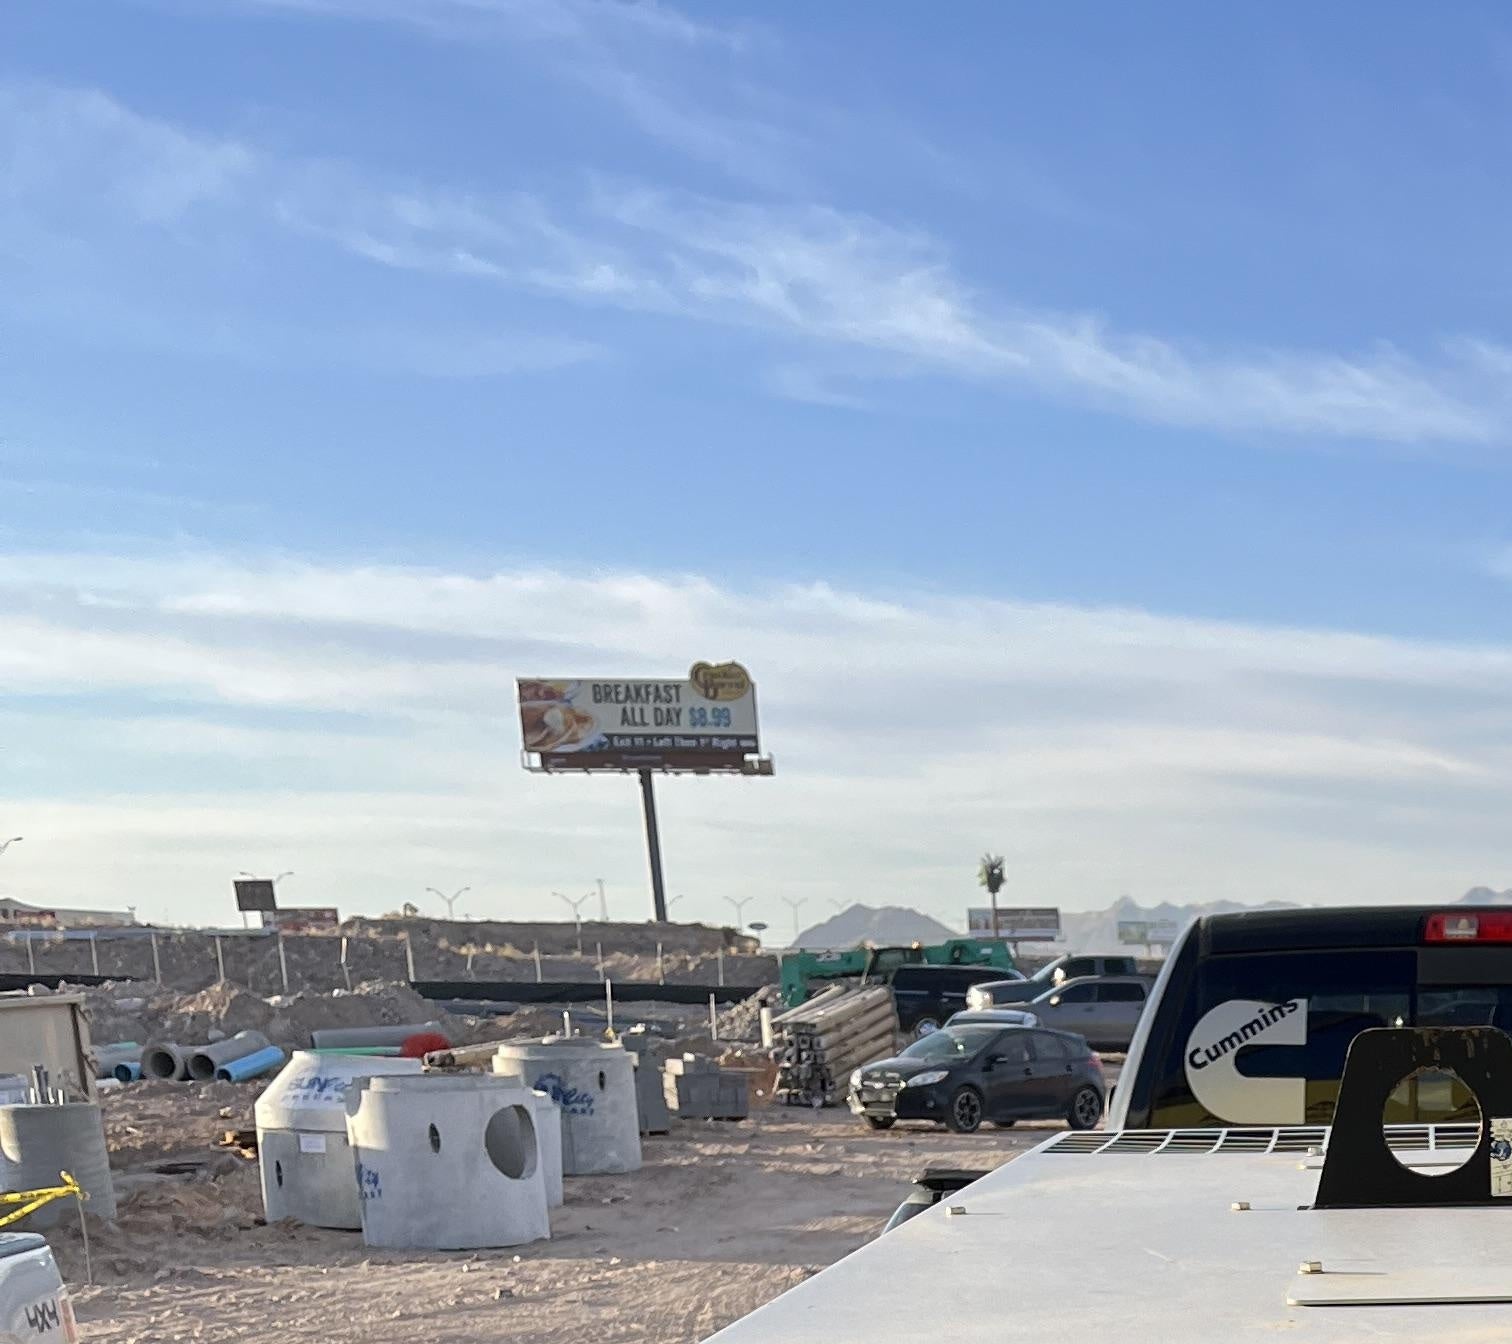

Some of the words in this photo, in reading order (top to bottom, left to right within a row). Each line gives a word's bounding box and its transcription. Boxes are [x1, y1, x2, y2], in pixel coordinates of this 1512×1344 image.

[592, 684, 682, 704] BREAKFAST
[621, 706, 649, 727] ALL
[654, 706, 682, 726] DAY
[1189, 1001, 1298, 1070] Cummins
